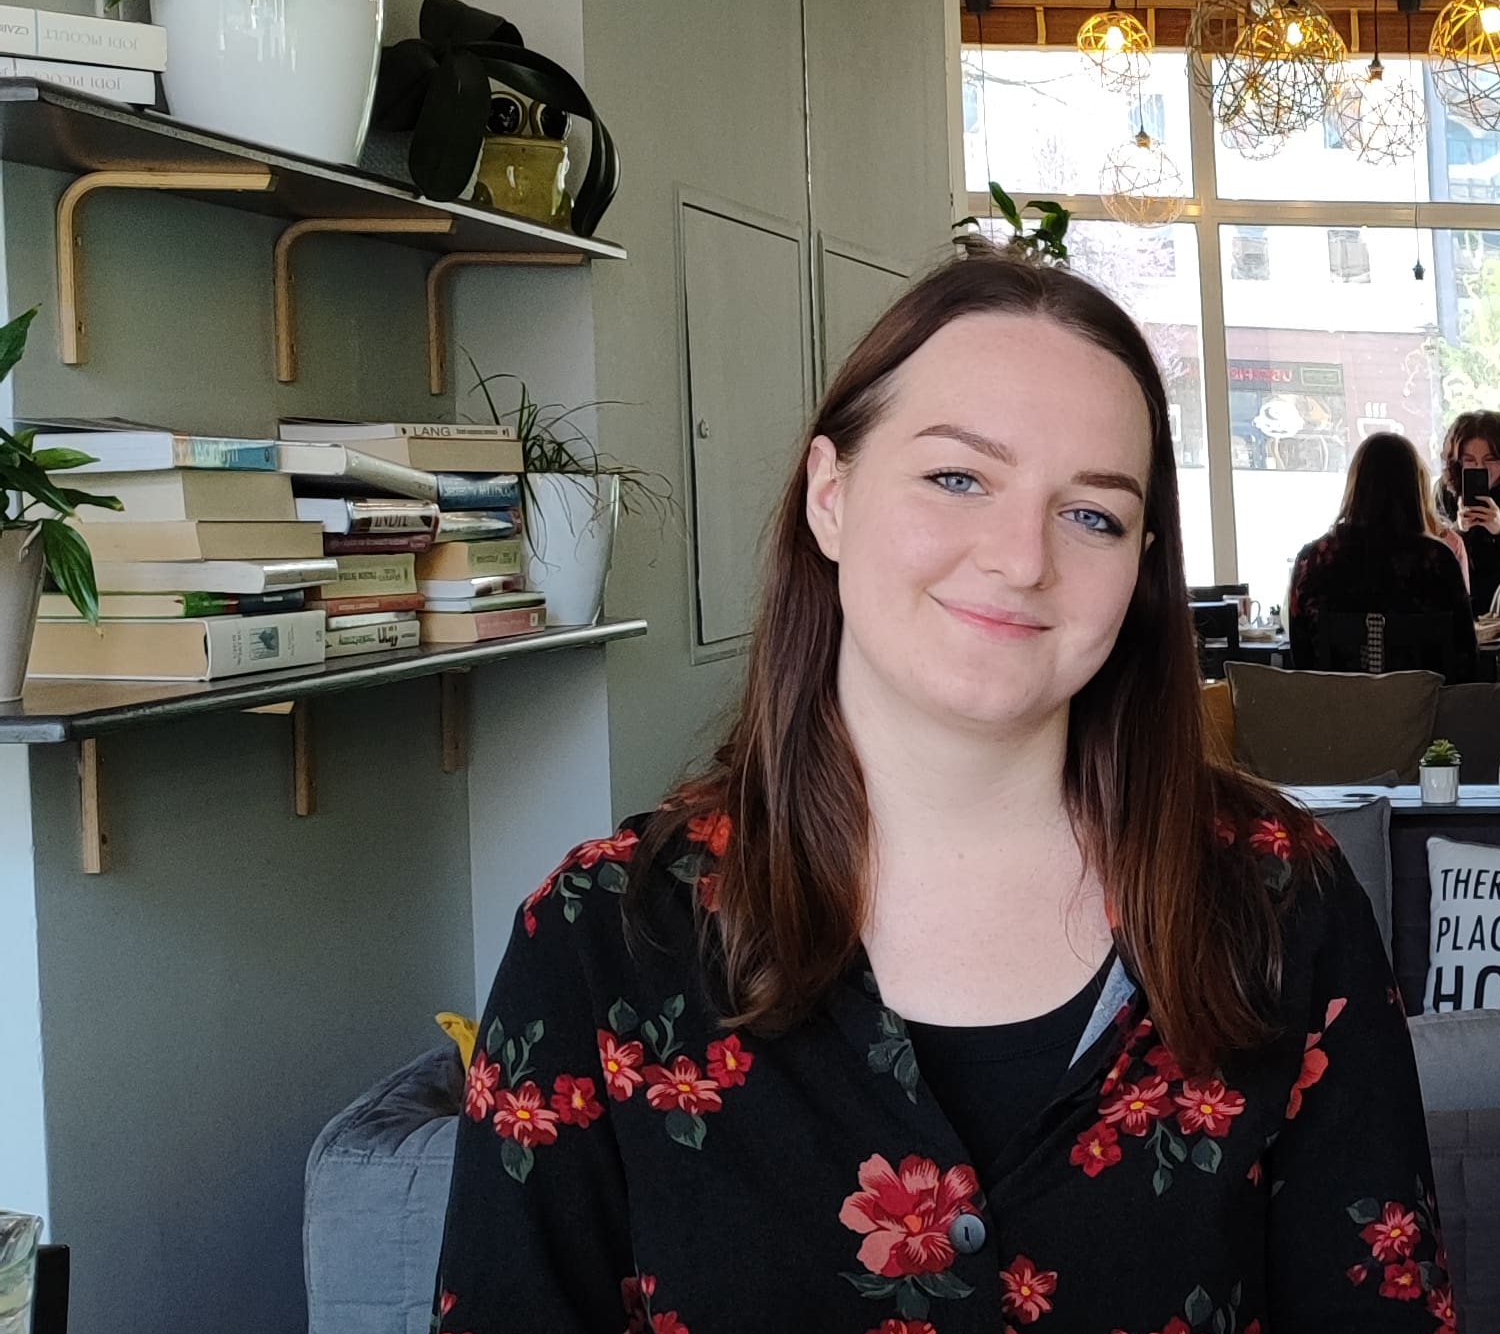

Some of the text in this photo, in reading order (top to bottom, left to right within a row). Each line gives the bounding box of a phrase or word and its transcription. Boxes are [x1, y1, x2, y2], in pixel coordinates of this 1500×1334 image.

[43, 29, 138, 51] JODI PICOULT
[91, 76, 121, 91] JODI
[413, 426, 451, 437] LANG
